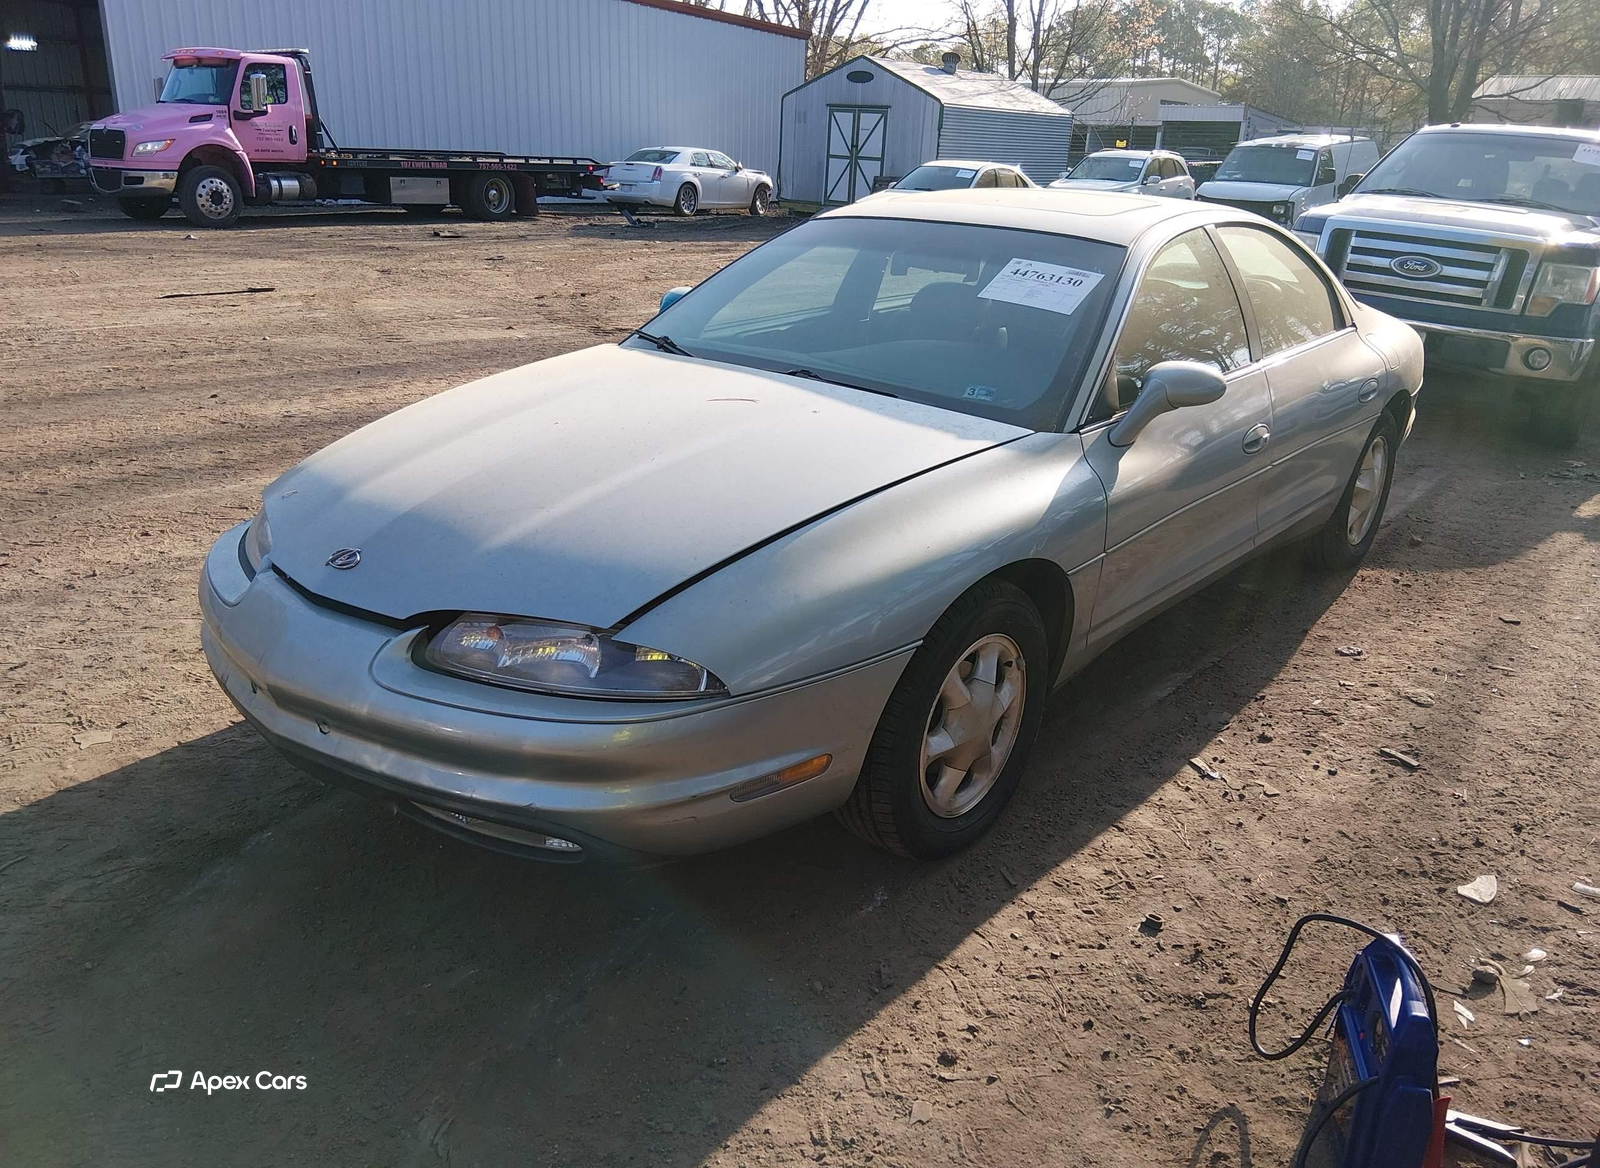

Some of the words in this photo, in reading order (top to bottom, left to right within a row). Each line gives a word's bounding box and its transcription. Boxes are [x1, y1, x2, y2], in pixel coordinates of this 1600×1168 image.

[431, 161, 448, 169] ROAD
[1403, 260, 1427, 272] Ford
[1010, 268, 1084, 288] 44763130
[967, 387, 976, 396] 3
